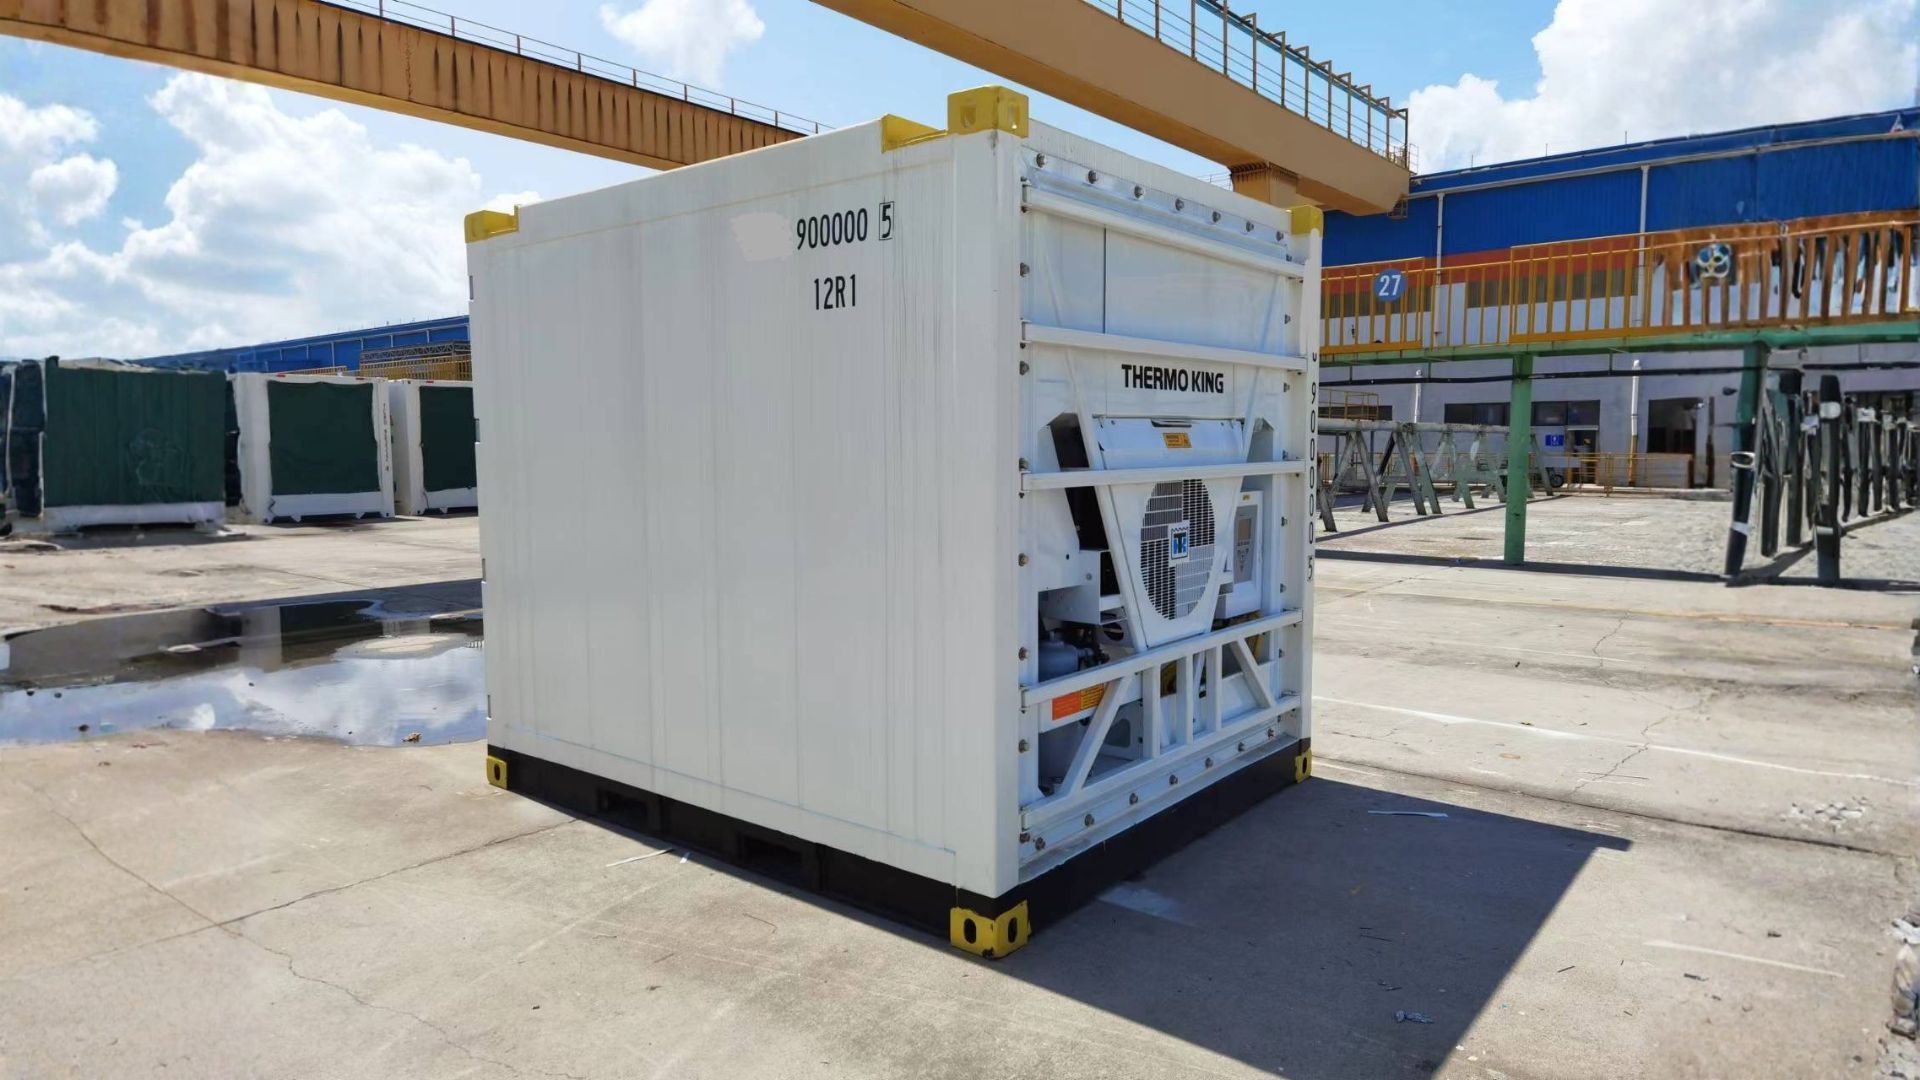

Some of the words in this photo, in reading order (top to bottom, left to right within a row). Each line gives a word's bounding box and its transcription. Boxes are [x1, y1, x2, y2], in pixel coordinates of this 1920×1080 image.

[797, 208, 868, 250] 900000
[881, 204, 892, 239] 5
[814, 274, 856, 310] 12R1
[1379, 274, 1401, 296] 27
[1121, 364, 1189, 392] THERMO
[1191, 370, 1224, 394] KING
[1308, 382, 1317, 544] 900000
